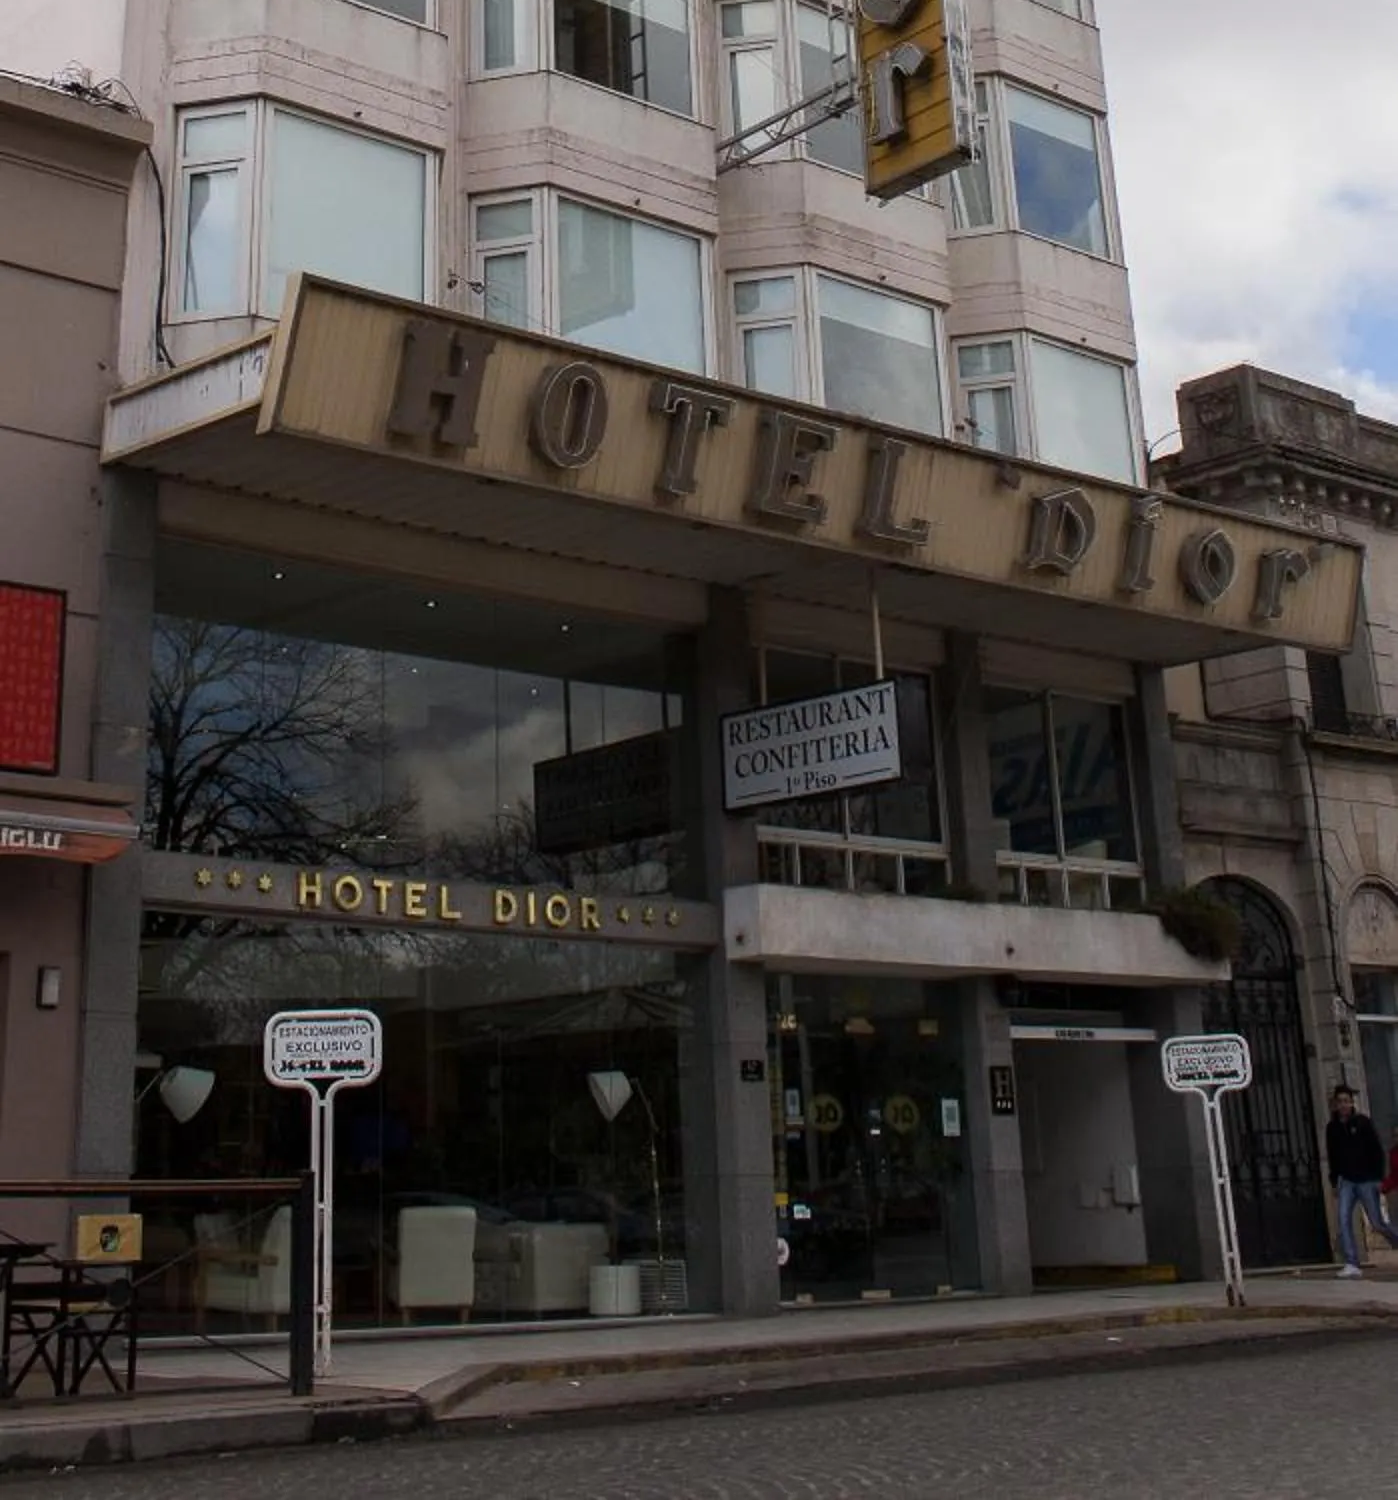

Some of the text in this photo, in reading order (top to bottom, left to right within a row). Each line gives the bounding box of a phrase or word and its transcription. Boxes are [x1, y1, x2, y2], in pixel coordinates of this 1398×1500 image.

[386, 318, 930, 548] HOTEL
[729, 687, 892, 747] RESTAURANT
[735, 725, 891, 779] CONFITERIA
[803, 771, 837, 790] Piso
[299, 872, 602, 930] HOTEL DIOR
[286, 1040, 363, 1052] EXCLUSIVO
